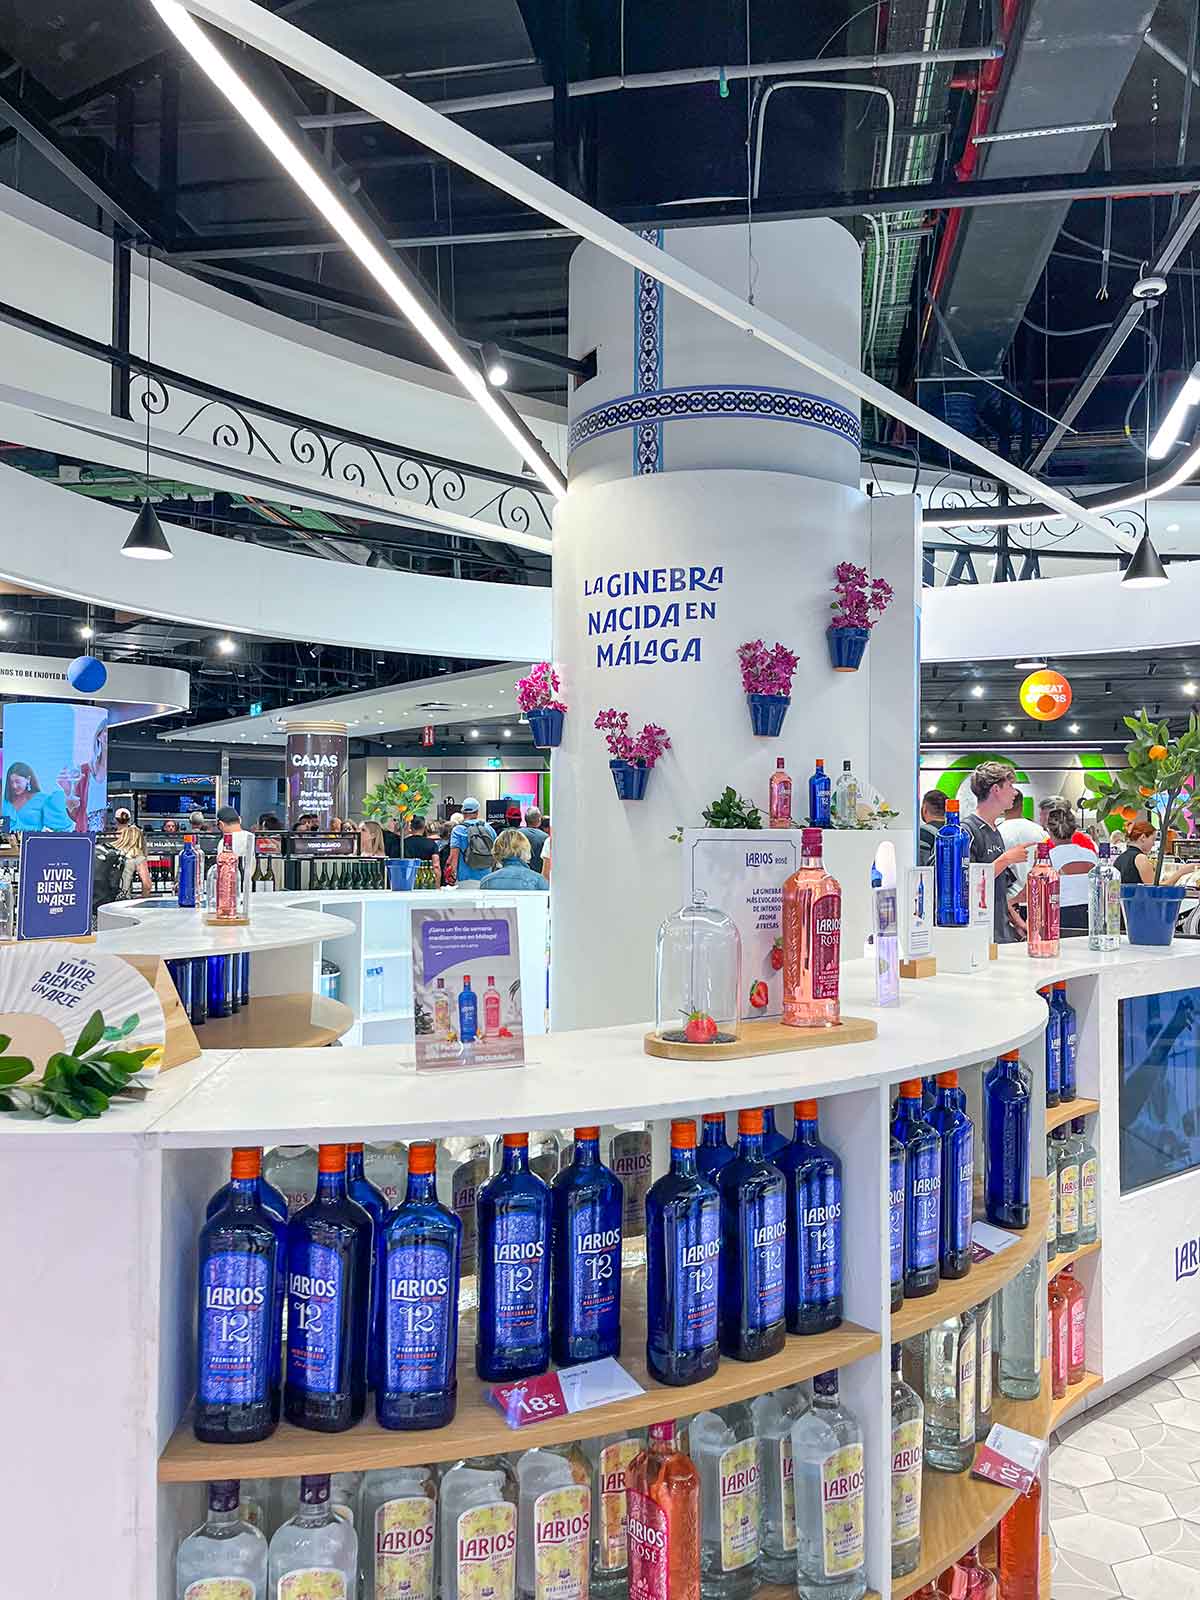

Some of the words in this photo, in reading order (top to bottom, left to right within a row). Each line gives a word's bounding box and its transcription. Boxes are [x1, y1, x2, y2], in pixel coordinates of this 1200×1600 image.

[585, 577, 603, 596] LA
[607, 566, 724, 598] GINEBRA
[588, 603, 680, 636] NACIDA
[686, 602, 716, 619] EN
[596, 634, 702, 668] MÁLAGA
[15, 669, 23, 677] TO
[25, 670, 33, 678] BE
[34, 671, 60, 680] ENJOYED
[292, 754, 339, 767] CAJAS
[745, 852, 773, 868] LARIOS
[37, 881, 62, 894] BIEN
[63, 881, 74, 890] ES
[43, 868, 77, 881] VIVIR
[37, 894, 50, 904] UN
[49, 893, 76, 907] ARTE
[38, 971, 75, 990] BIEN
[70, 980, 88, 992] ES
[56, 961, 96, 985] VIVIR
[31, 983, 48, 995] UN
[41, 989, 81, 1009] ARTE
[455, 1186, 474, 1211] LAR
[889, 1188, 905, 1207] RIOS
[914, 1176, 941, 1197] LARIOS
[804, 1203, 841, 1228] LARIOS
[578, 1228, 621, 1255] LARIOS
[754, 1219, 786, 1249] LARIOS
[810, 1227, 835, 1252] 12
[494, 1241, 544, 1265] LARIOS
[682, 1238, 721, 1268] LARIOS
[501, 1266, 534, 1292] 12
[584, 1254, 613, 1281] 12
[689, 1263, 713, 1296] 12
[206, 1286, 265, 1311] LARIOS
[290, 1272, 337, 1300] LARIOS
[391, 1277, 449, 1302] LARIOS
[213, 1314, 251, 1343] 12
[294, 1302, 323, 1334] 12
[398, 1303, 436, 1333] 12
[892, 1447, 922, 1473] ARIO
[601, 1471, 626, 1495] LAR
[722, 1463, 761, 1497] LARIOS
[824, 1470, 864, 1501] LARIOS
[376, 1525, 434, 1555] LARIOS
[537, 1513, 589, 1544] LARIOS
[627, 1515, 665, 1549] LARIOS
[459, 1530, 515, 1561] LARIOS
[630, 1537, 658, 1564] ROSÉ
